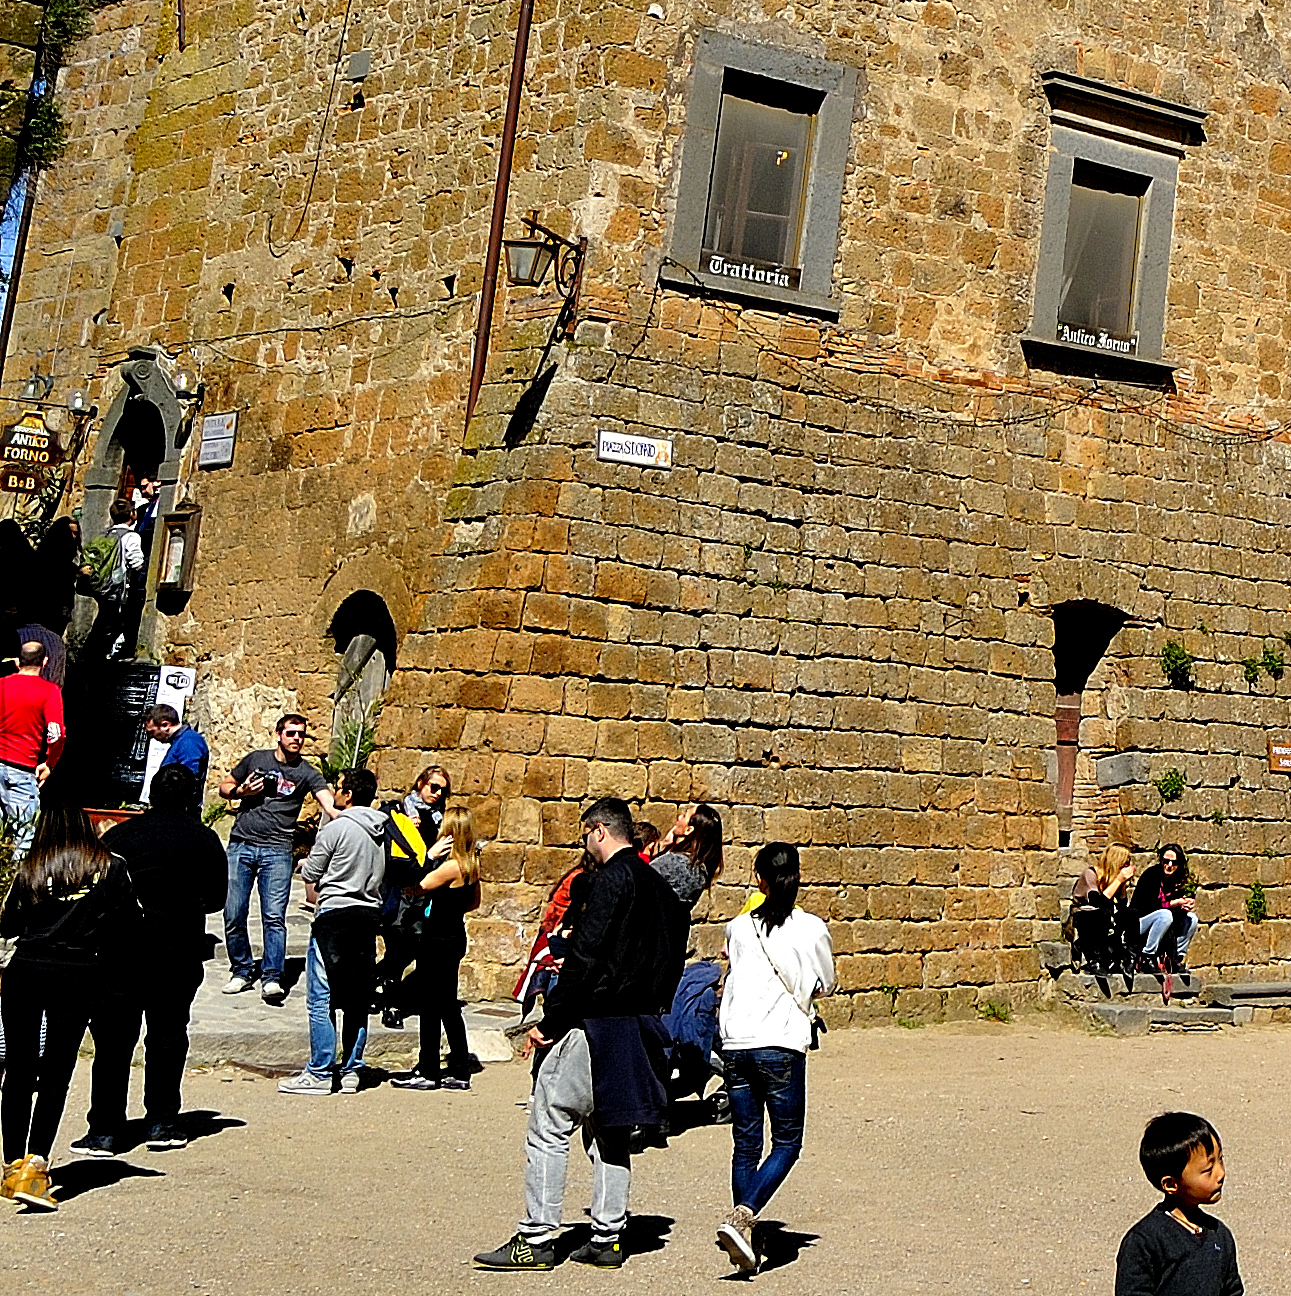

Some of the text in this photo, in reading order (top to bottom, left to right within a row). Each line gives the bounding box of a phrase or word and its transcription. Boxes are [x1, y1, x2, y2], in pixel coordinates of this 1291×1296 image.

[709, 254, 790, 288] Trattoria
[10, 431, 49, 449] ANTICO
[3, 446, 50, 463] FORNO
